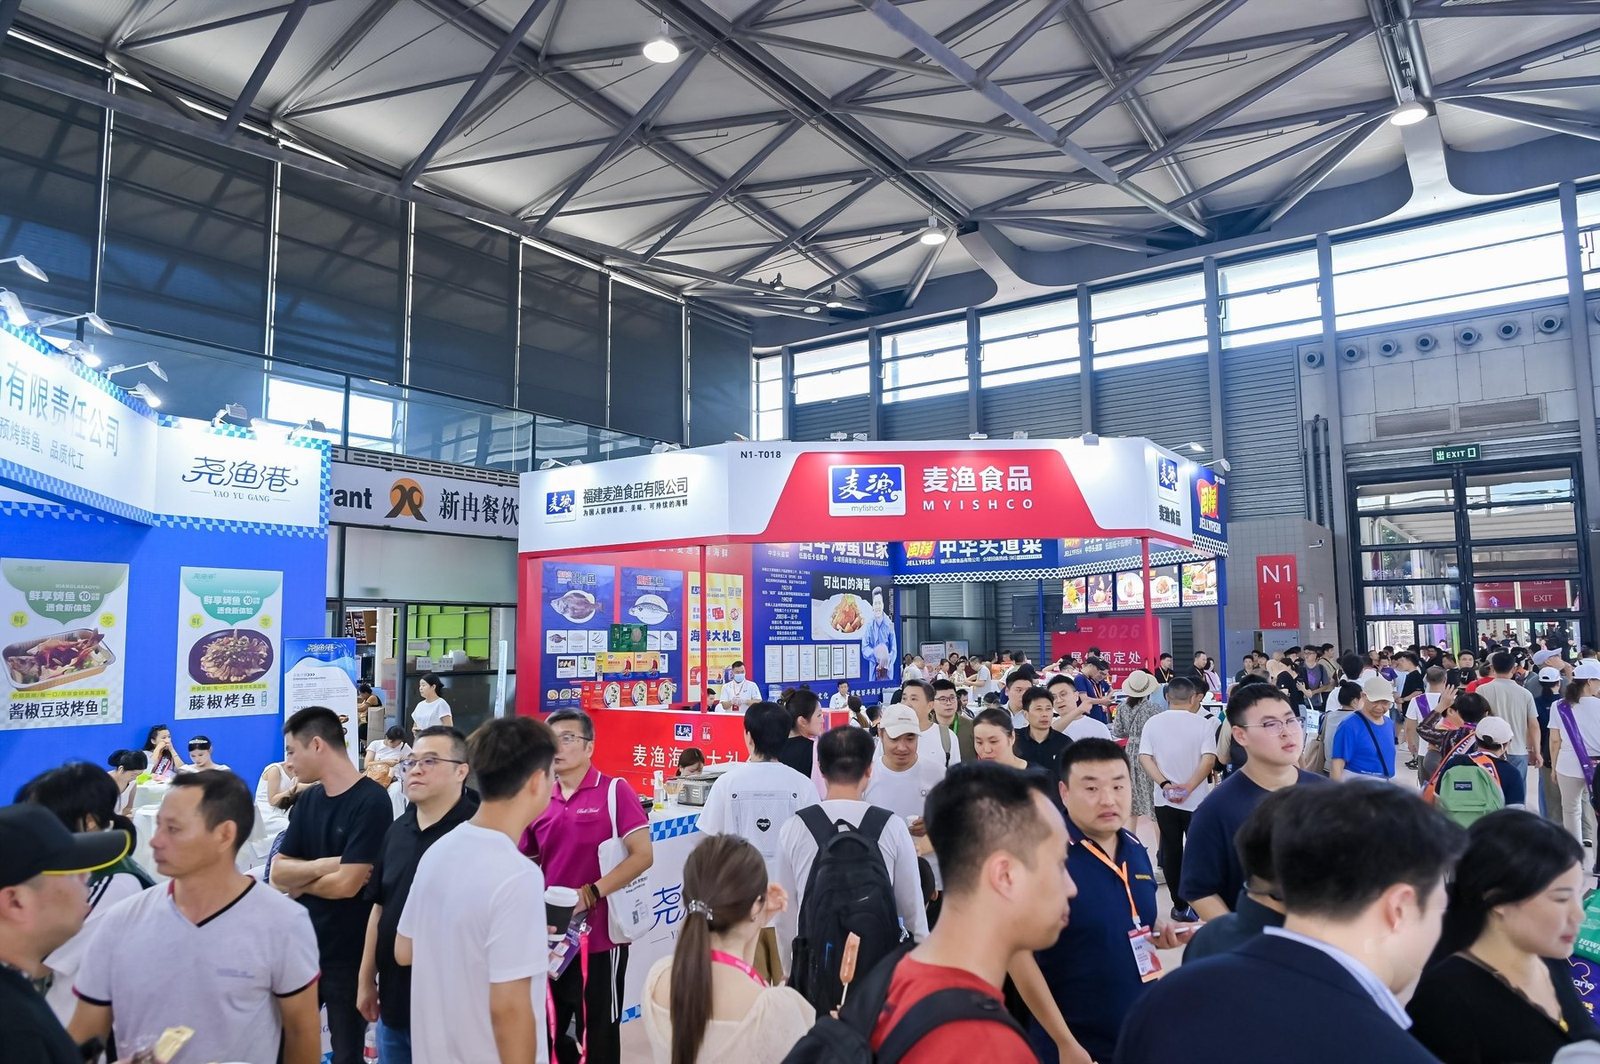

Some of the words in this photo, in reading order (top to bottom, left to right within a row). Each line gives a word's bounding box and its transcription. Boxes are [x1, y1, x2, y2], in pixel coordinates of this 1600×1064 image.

[740, 451, 781, 459] N1-T018
[1446, 450, 1465, 459] EXIT
[182, 457, 298, 492] 尧渔港
[838, 469, 895, 498] 麦渔
[923, 466, 1032, 492] 麦渔食品
[213, 490, 229, 498] YAO
[233, 491, 244, 499] YU
[247, 493, 270, 502] GANG
[330, 488, 372, 510] ant
[583, 476, 688, 504] 福建麦渔食品有限公司
[923, 499, 1033, 510] MYISHCO
[1159, 505, 1181, 526] 麦渔食品
[823, 576, 871, 591] 可出口的海蜇
[1263, 564, 1291, 584] N1
[1533, 594, 1553, 603] EXIT
[1274, 600, 1281, 618] 1
[1097, 624, 1141, 639] 2026
[9, 700, 99, 720] 酱椒豆豉烤鱼
[189, 693, 256, 711] 藤椒烤鱼
[633, 744, 751, 768] 麦渔海大礼
